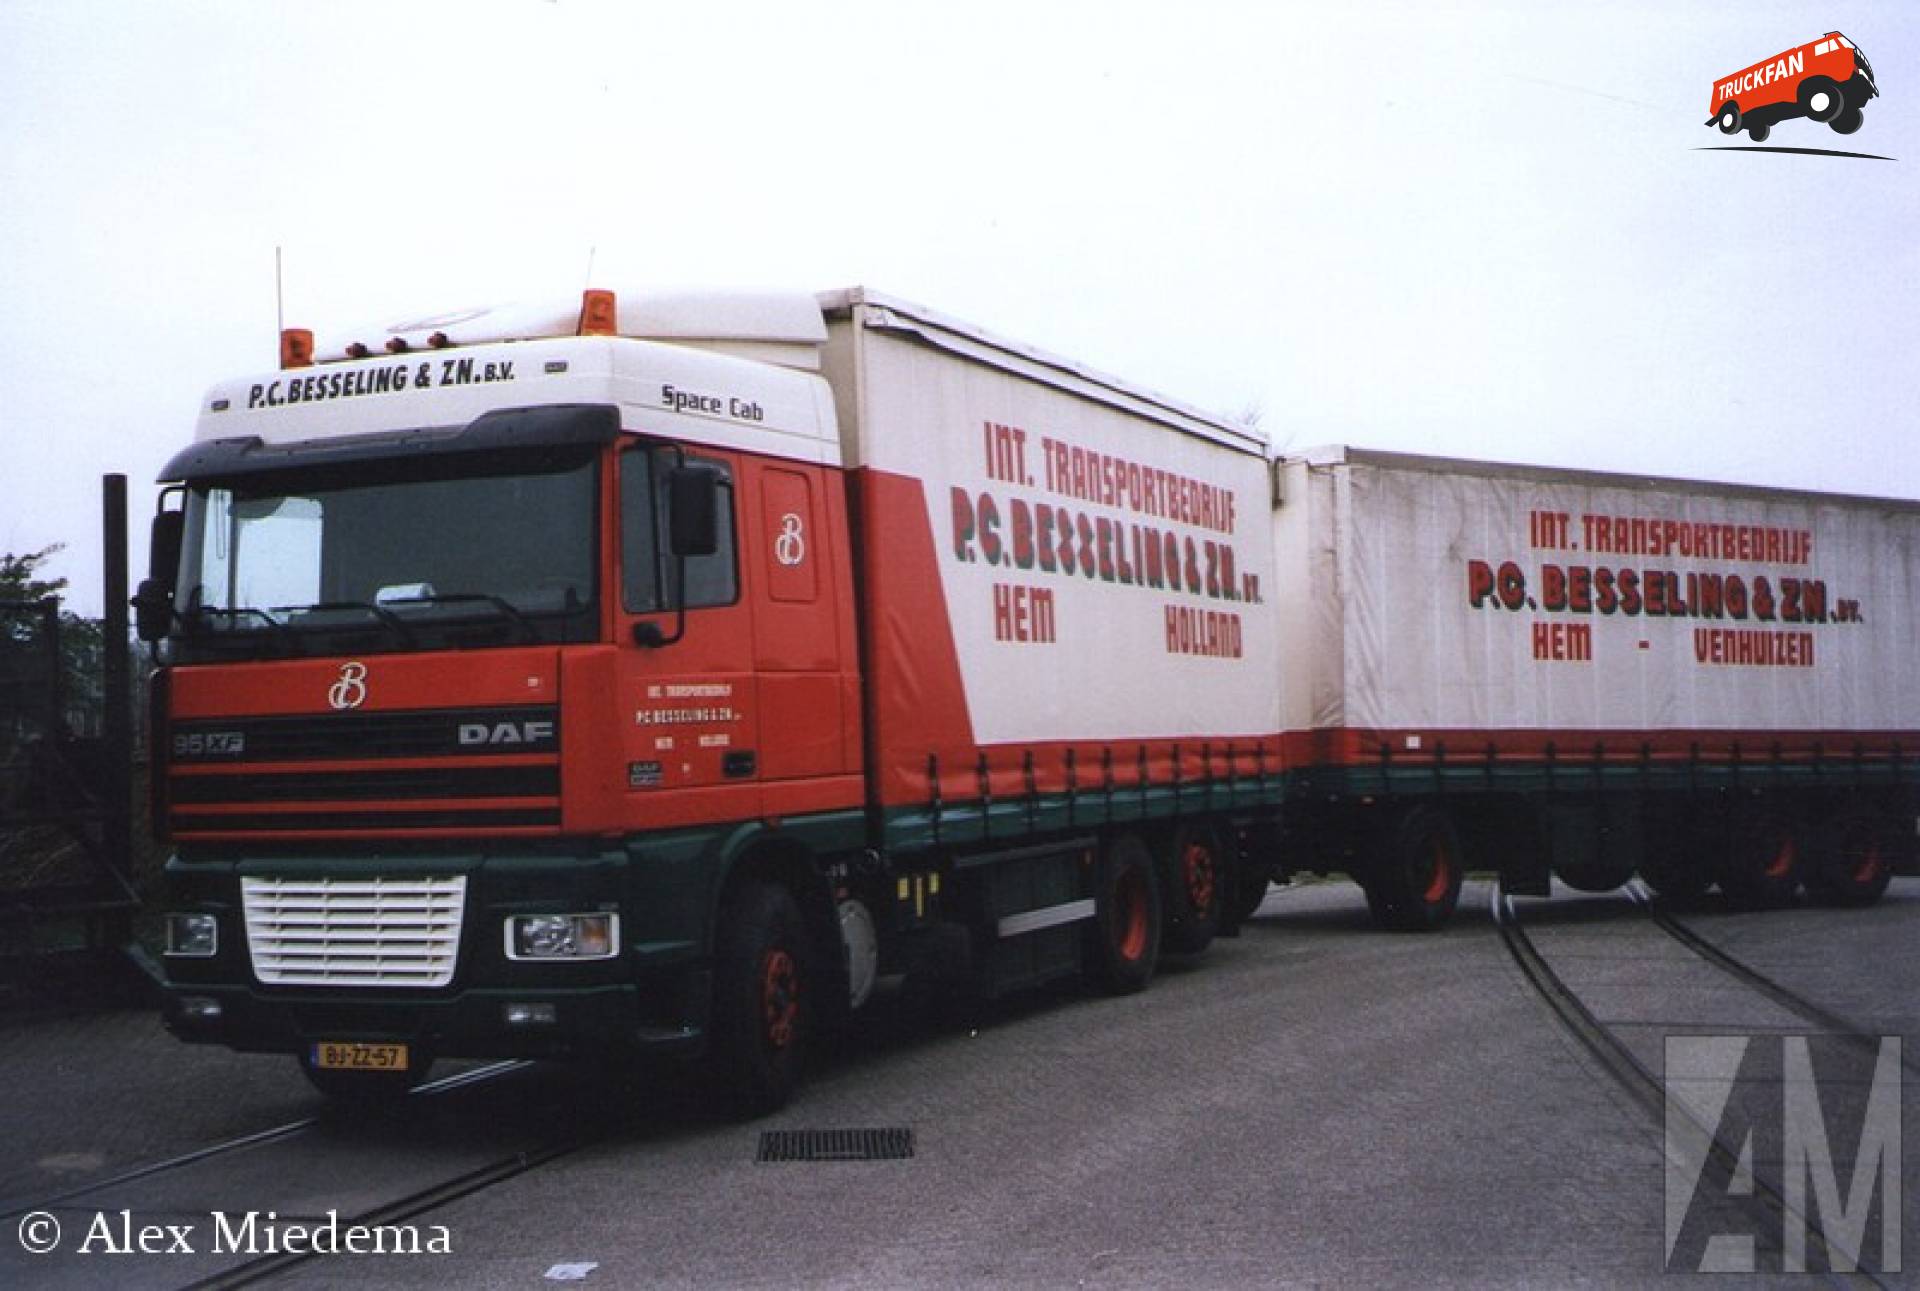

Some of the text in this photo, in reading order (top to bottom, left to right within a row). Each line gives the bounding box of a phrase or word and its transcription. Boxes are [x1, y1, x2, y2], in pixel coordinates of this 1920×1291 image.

[662, 384, 763, 421] Space Cab
[984, 421, 1235, 535] INT. TRANSPORTBEDRIJF
[1530, 510, 1812, 564] INT. TRANSPORTBEDRIJF
[993, 583, 1242, 658] HEM HOLLAND
[1751, 575, 1777, 622] &
[1532, 622, 1591, 661] HEM
[1694, 628, 1814, 666] VENHUIZEN
[458, 721, 552, 745] DAF
[326, 1046, 399, 1066] BJ-ZZ-57
